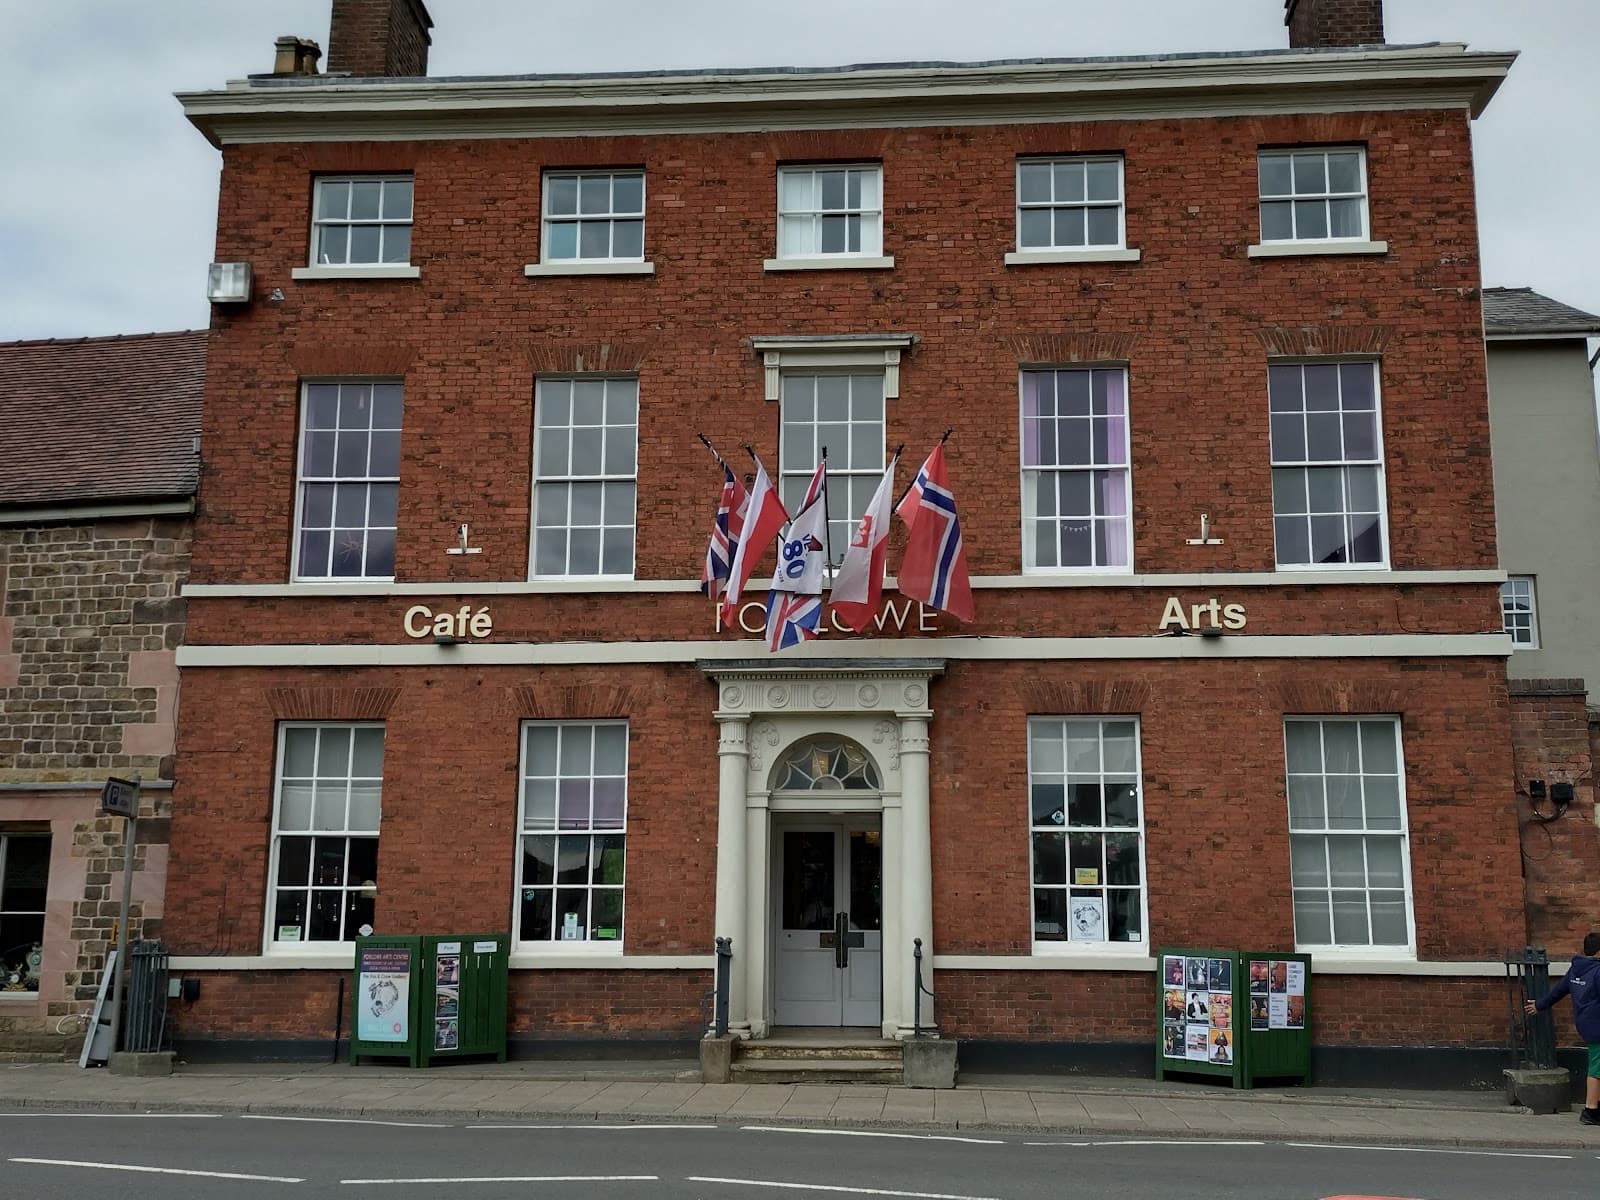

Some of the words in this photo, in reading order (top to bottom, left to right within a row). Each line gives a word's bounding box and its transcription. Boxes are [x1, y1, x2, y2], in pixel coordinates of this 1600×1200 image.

[783, 540, 805, 579] 80
[403, 605, 493, 638] Café
[1159, 597, 1247, 630] Arts
